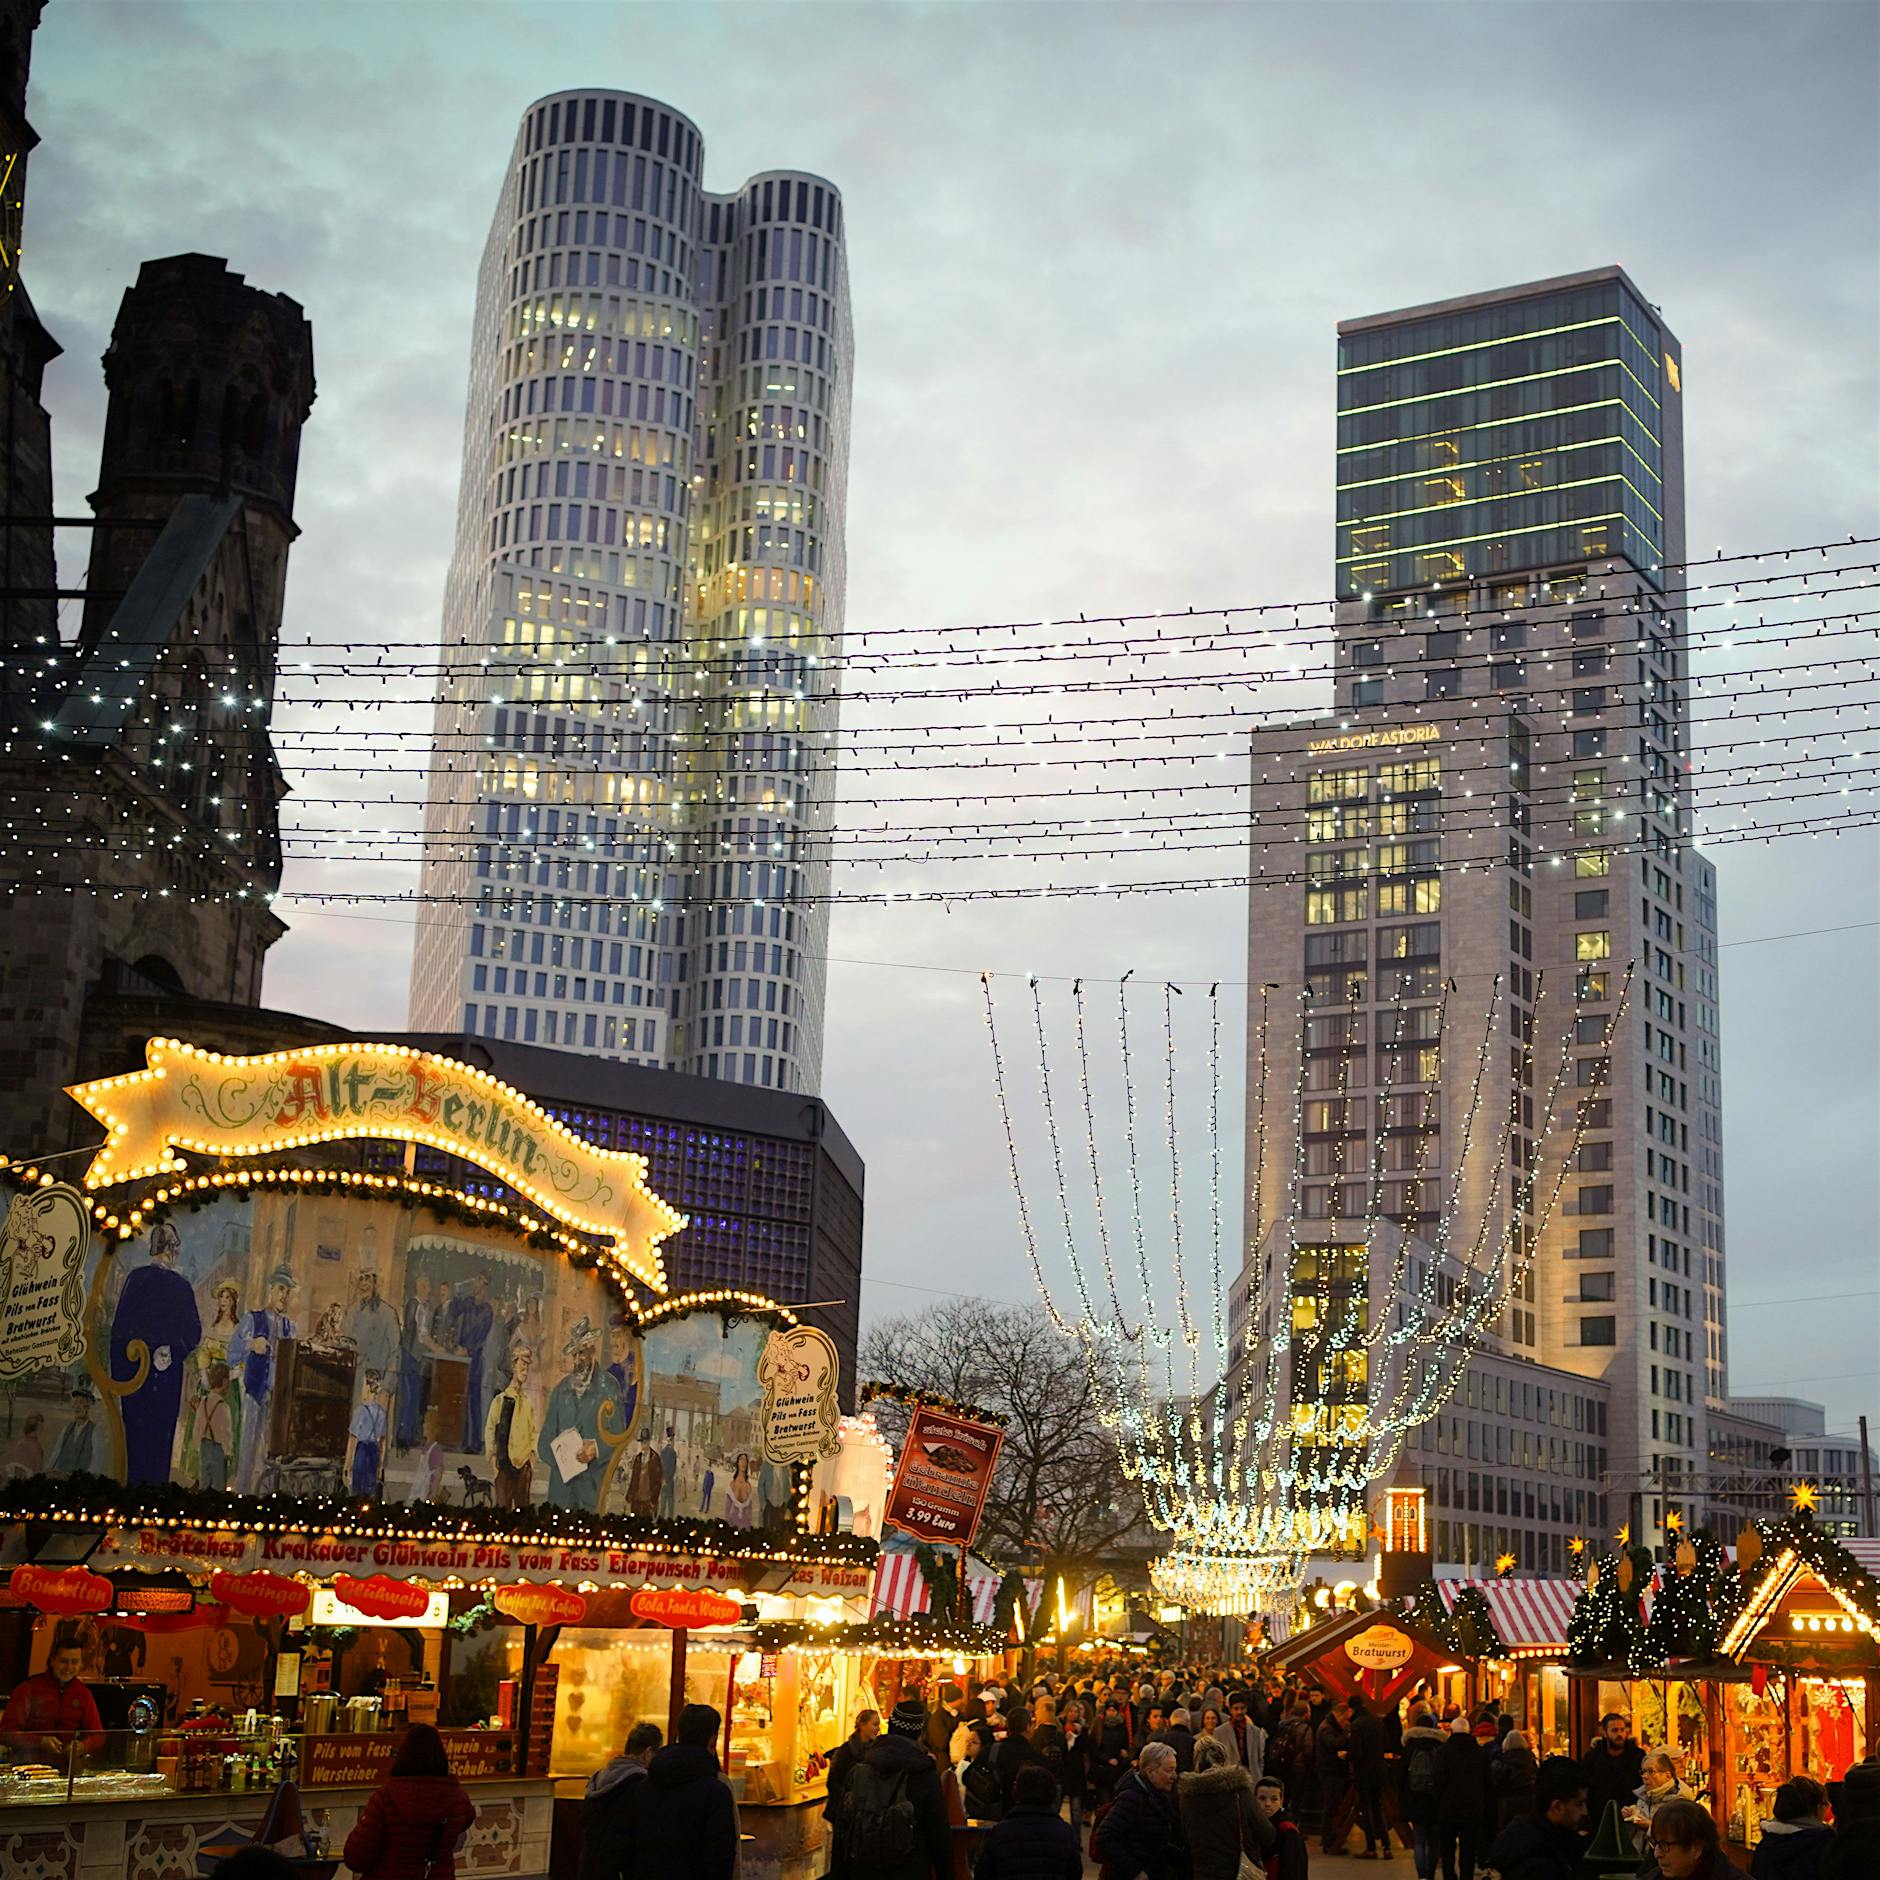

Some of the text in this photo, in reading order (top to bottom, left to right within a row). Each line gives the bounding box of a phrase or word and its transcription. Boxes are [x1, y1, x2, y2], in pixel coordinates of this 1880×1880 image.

[1309, 725, 1441, 756] WALDORF ASTORIA
[274, 1058, 539, 1175] Alt-Berlin
[12, 1275, 57, 1298] Glühwein
[4, 1302, 24, 1318] Pils
[37, 1295, 60, 1310] Fass
[6, 1312, 57, 1335] Bratwurst
[776, 1393, 814, 1408] Glühwein
[771, 1411, 787, 1421] Pils
[798, 1408, 817, 1418] Fass
[774, 1420, 816, 1435] Bratwurst
[953, 1428, 988, 1452] frisch
[911, 1497, 960, 1517] 150 Gramm
[932, 1513, 957, 1531] Euro
[138, 1530, 246, 1559] Brötchen
[261, 1536, 369, 1564] Krakauer
[373, 1542, 468, 1569] Glühwein
[472, 1546, 511, 1569] Pils
[518, 1553, 553, 1571] vom
[558, 1552, 599, 1572] Fass
[607, 1553, 701, 1580] Eierpunsch
[705, 1560, 744, 1580] Pomm
[790, 1568, 814, 1584] tes
[821, 1567, 867, 1587] Weizen
[342, 1580, 425, 1609] Glühwein
[549, 1597, 581, 1617] Kakao
[699, 1601, 736, 1619] Wasser
[1352, 1646, 1406, 1658] Bratwurst
[313, 1740, 391, 1760] Pils vom Fass
[311, 1765, 378, 1783] Warsteiner
